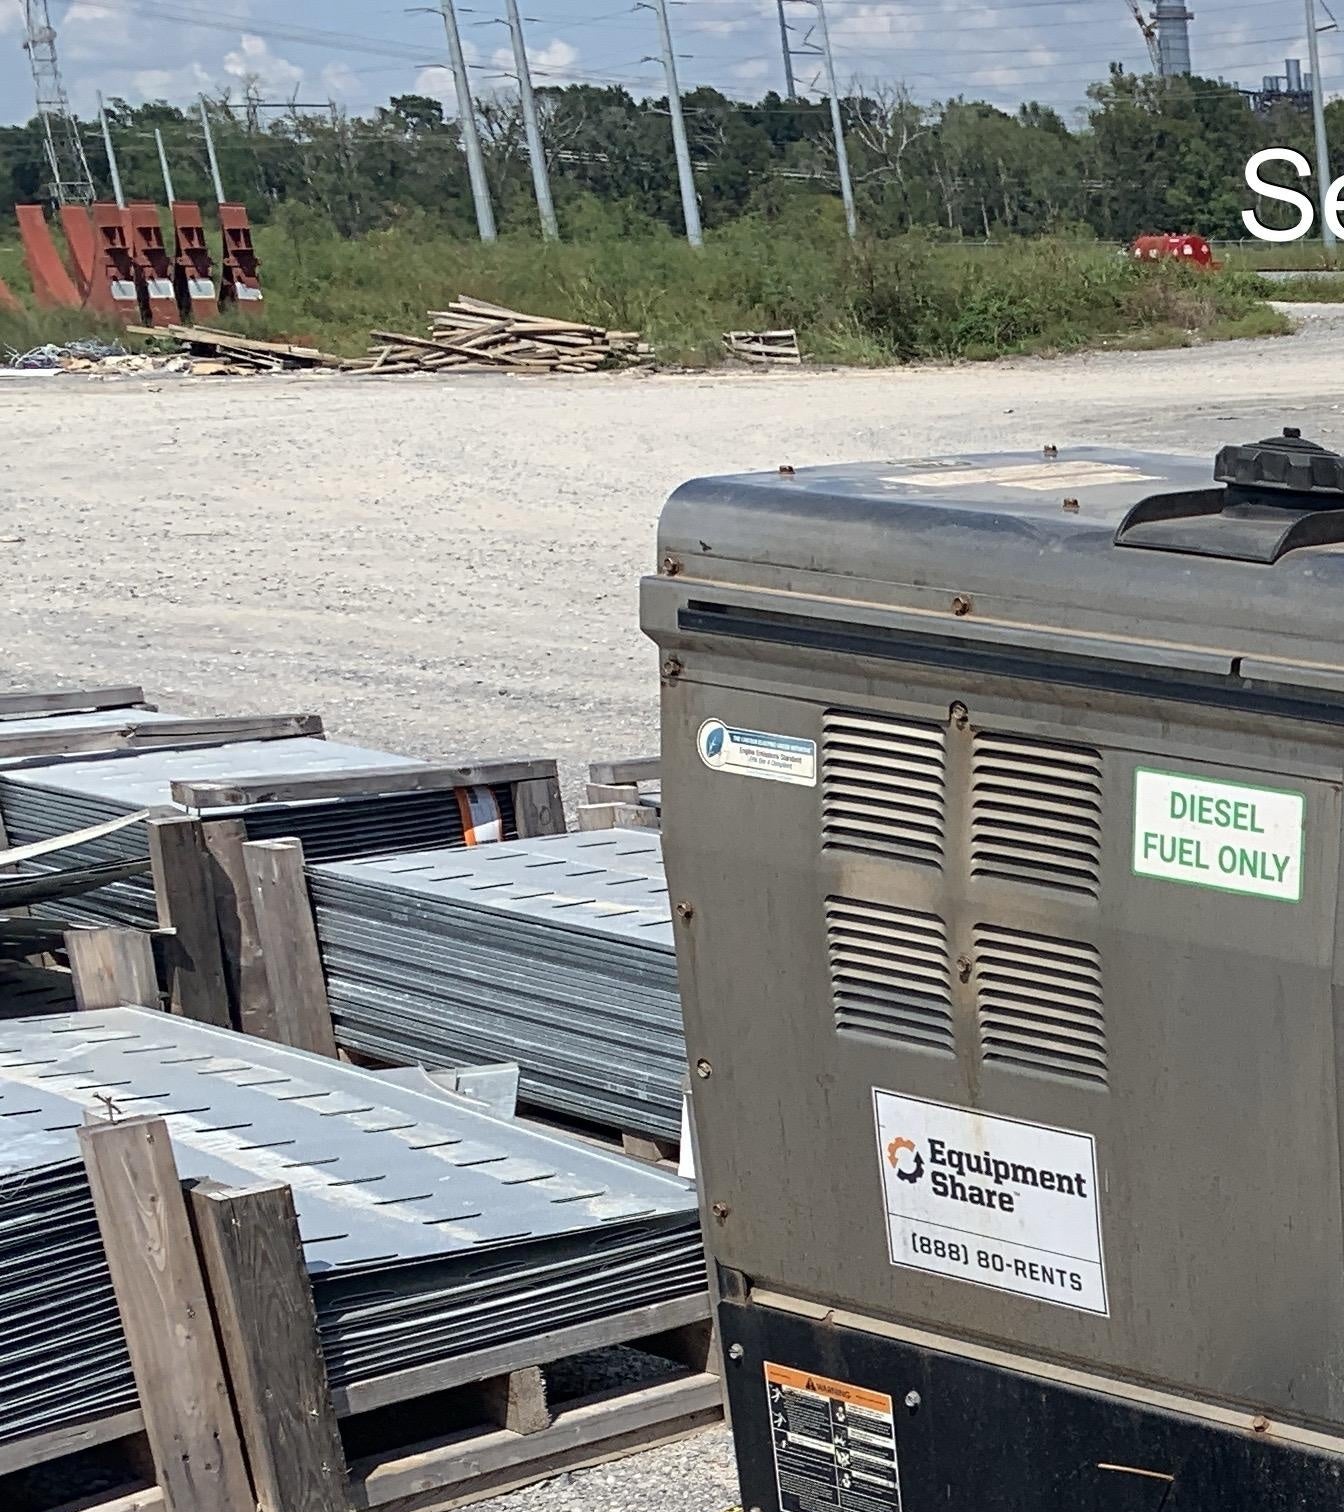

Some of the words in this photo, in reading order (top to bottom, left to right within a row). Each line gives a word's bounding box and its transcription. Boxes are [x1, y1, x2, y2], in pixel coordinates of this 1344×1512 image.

[1170, 790, 1265, 834] DIESEL
[1143, 831, 1210, 870] FUEL
[1218, 845, 1290, 883] ONLY
[927, 1138, 1088, 1198] Equipment
[931, 1170, 1015, 1213] Share
[911, 1232, 969, 1265] (888)
[977, 1250, 1083, 1291] 80-RENTS
